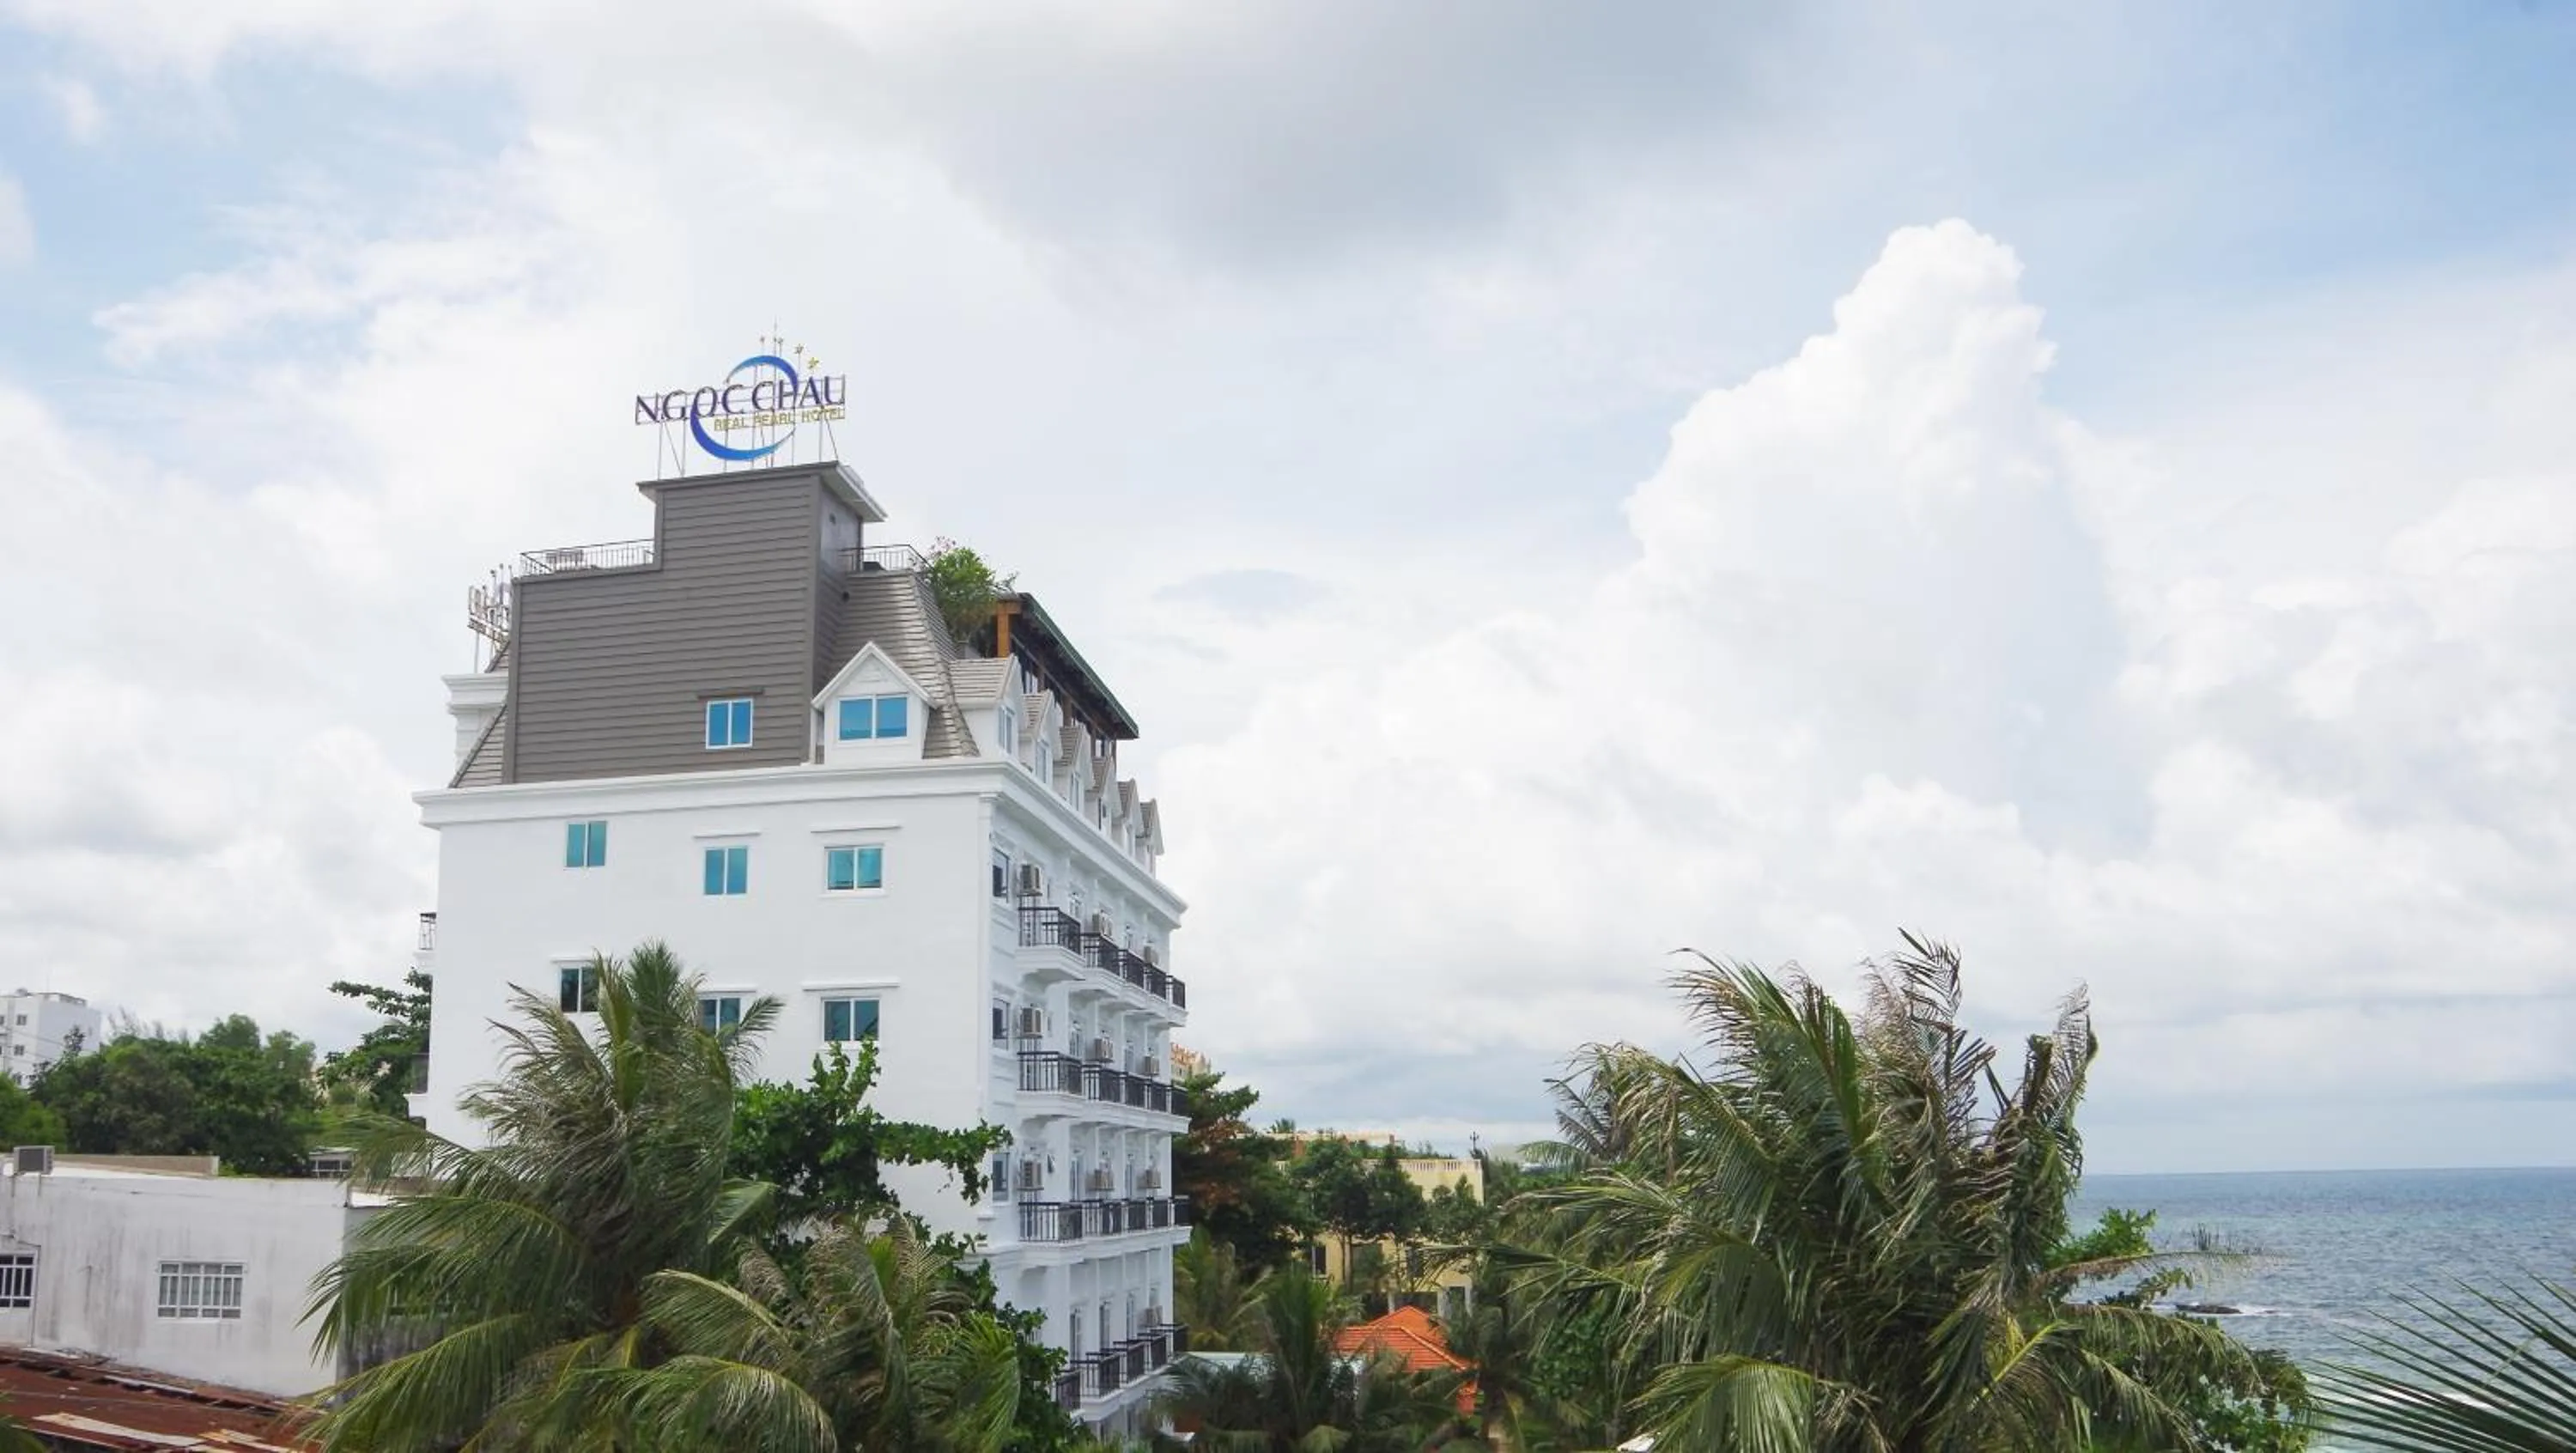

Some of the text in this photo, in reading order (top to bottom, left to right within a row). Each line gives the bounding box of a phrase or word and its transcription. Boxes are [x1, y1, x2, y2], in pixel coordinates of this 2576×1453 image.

[714, 406, 845, 431] REAL PEARL HOTEL
